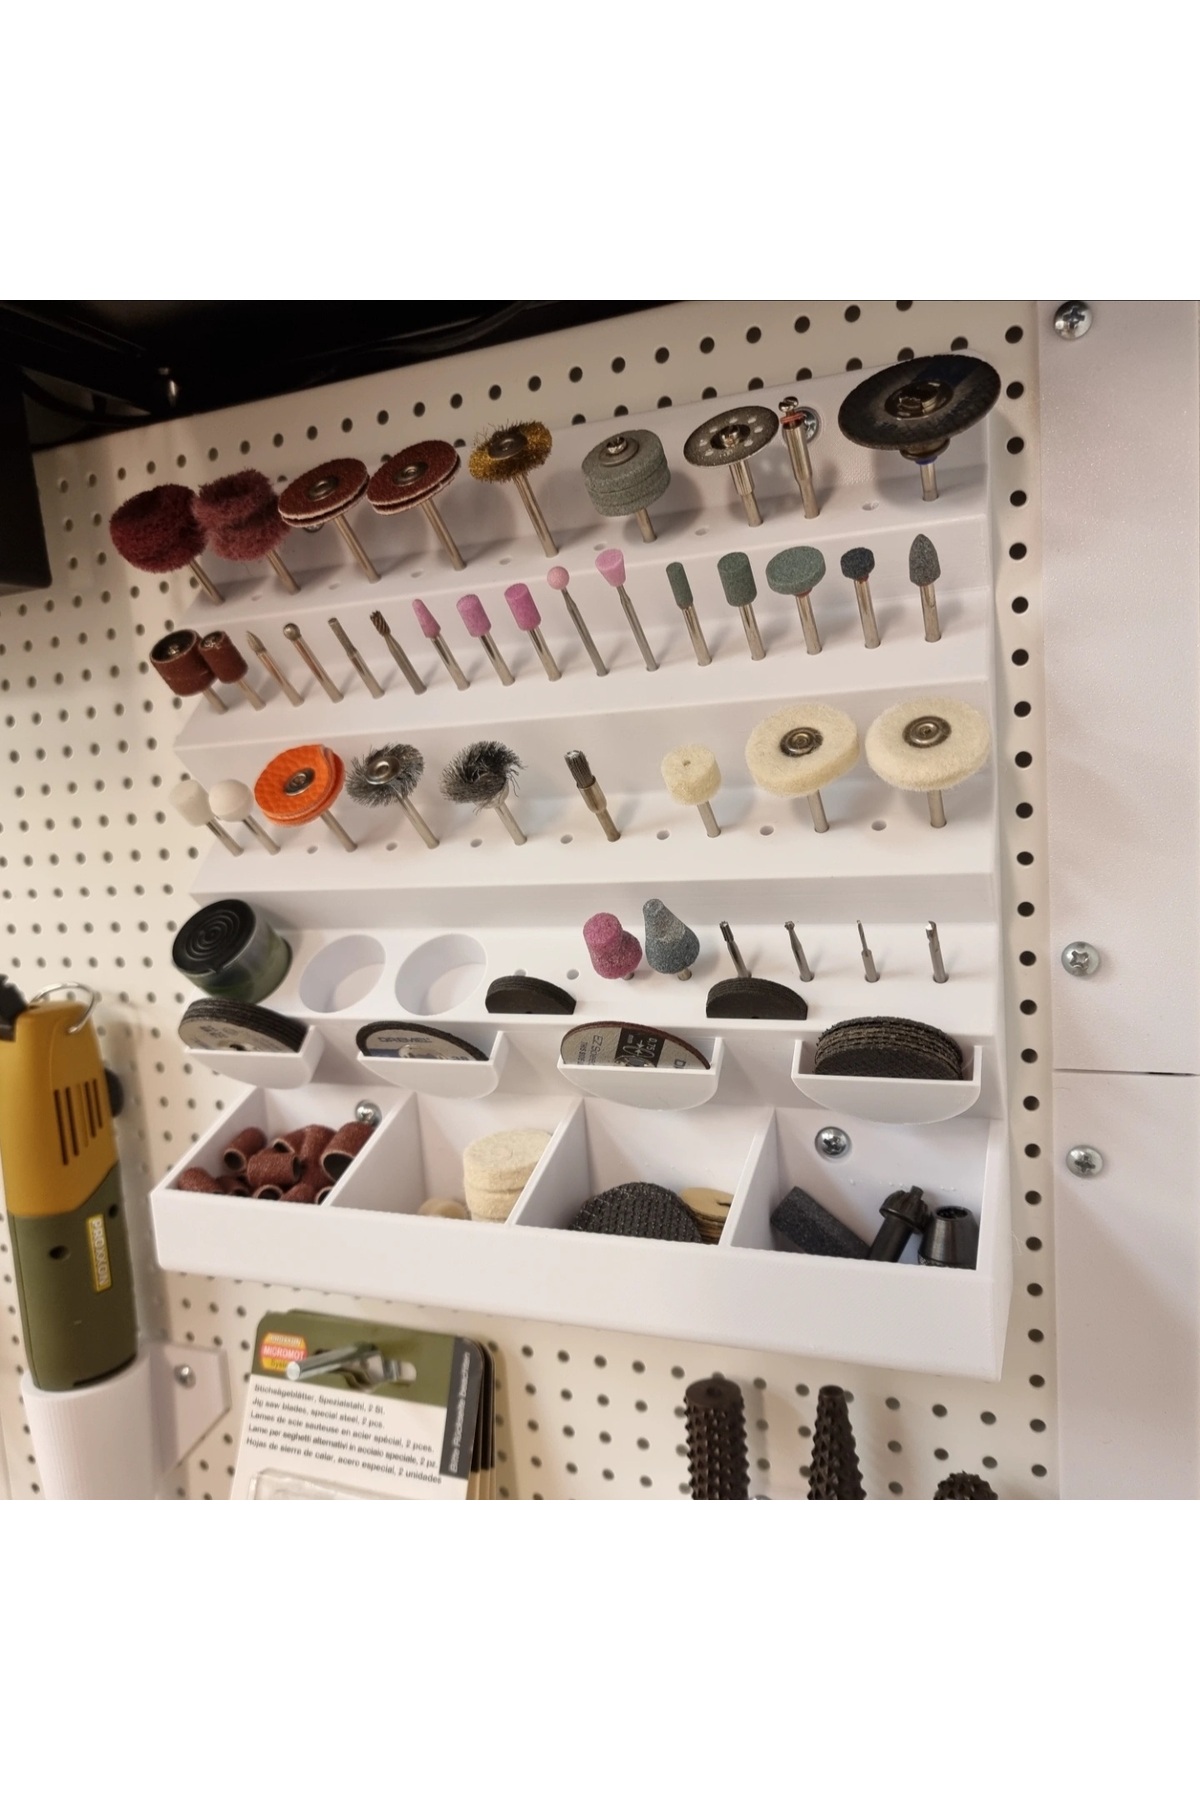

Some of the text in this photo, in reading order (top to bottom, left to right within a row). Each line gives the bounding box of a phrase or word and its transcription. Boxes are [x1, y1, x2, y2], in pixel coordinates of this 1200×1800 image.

[92, 1217, 108, 1285] PROXXON
[263, 1345, 304, 1361] MICROMOT
[252, 1397, 385, 1429] Jig saw blades, special steel, 2 pcs.
[318, 1395, 366, 1412] Spezialstahl,
[368, 1404, 373, 1412] 2
[449, 1352, 470, 1474] Bitte Rückseite beachten
[248, 1424, 268, 1434] Lame
[269, 1429, 281, 1437] per
[283, 1431, 312, 1443] seghetti
[313, 1436, 348, 1450] alternativi
[357, 1446, 384, 1458] acciaio
[385, 1451, 418, 1466] speciale,
[420, 1457, 425, 1465] 2
[426, 1460, 438, 1469] pz.
[250, 1410, 434, 1453] Lames de scie sauteuse en acier spécial, 2 pces.
[246, 1437, 442, 1484] Hojas de sierra de calar, acero especial, 2 unidades
